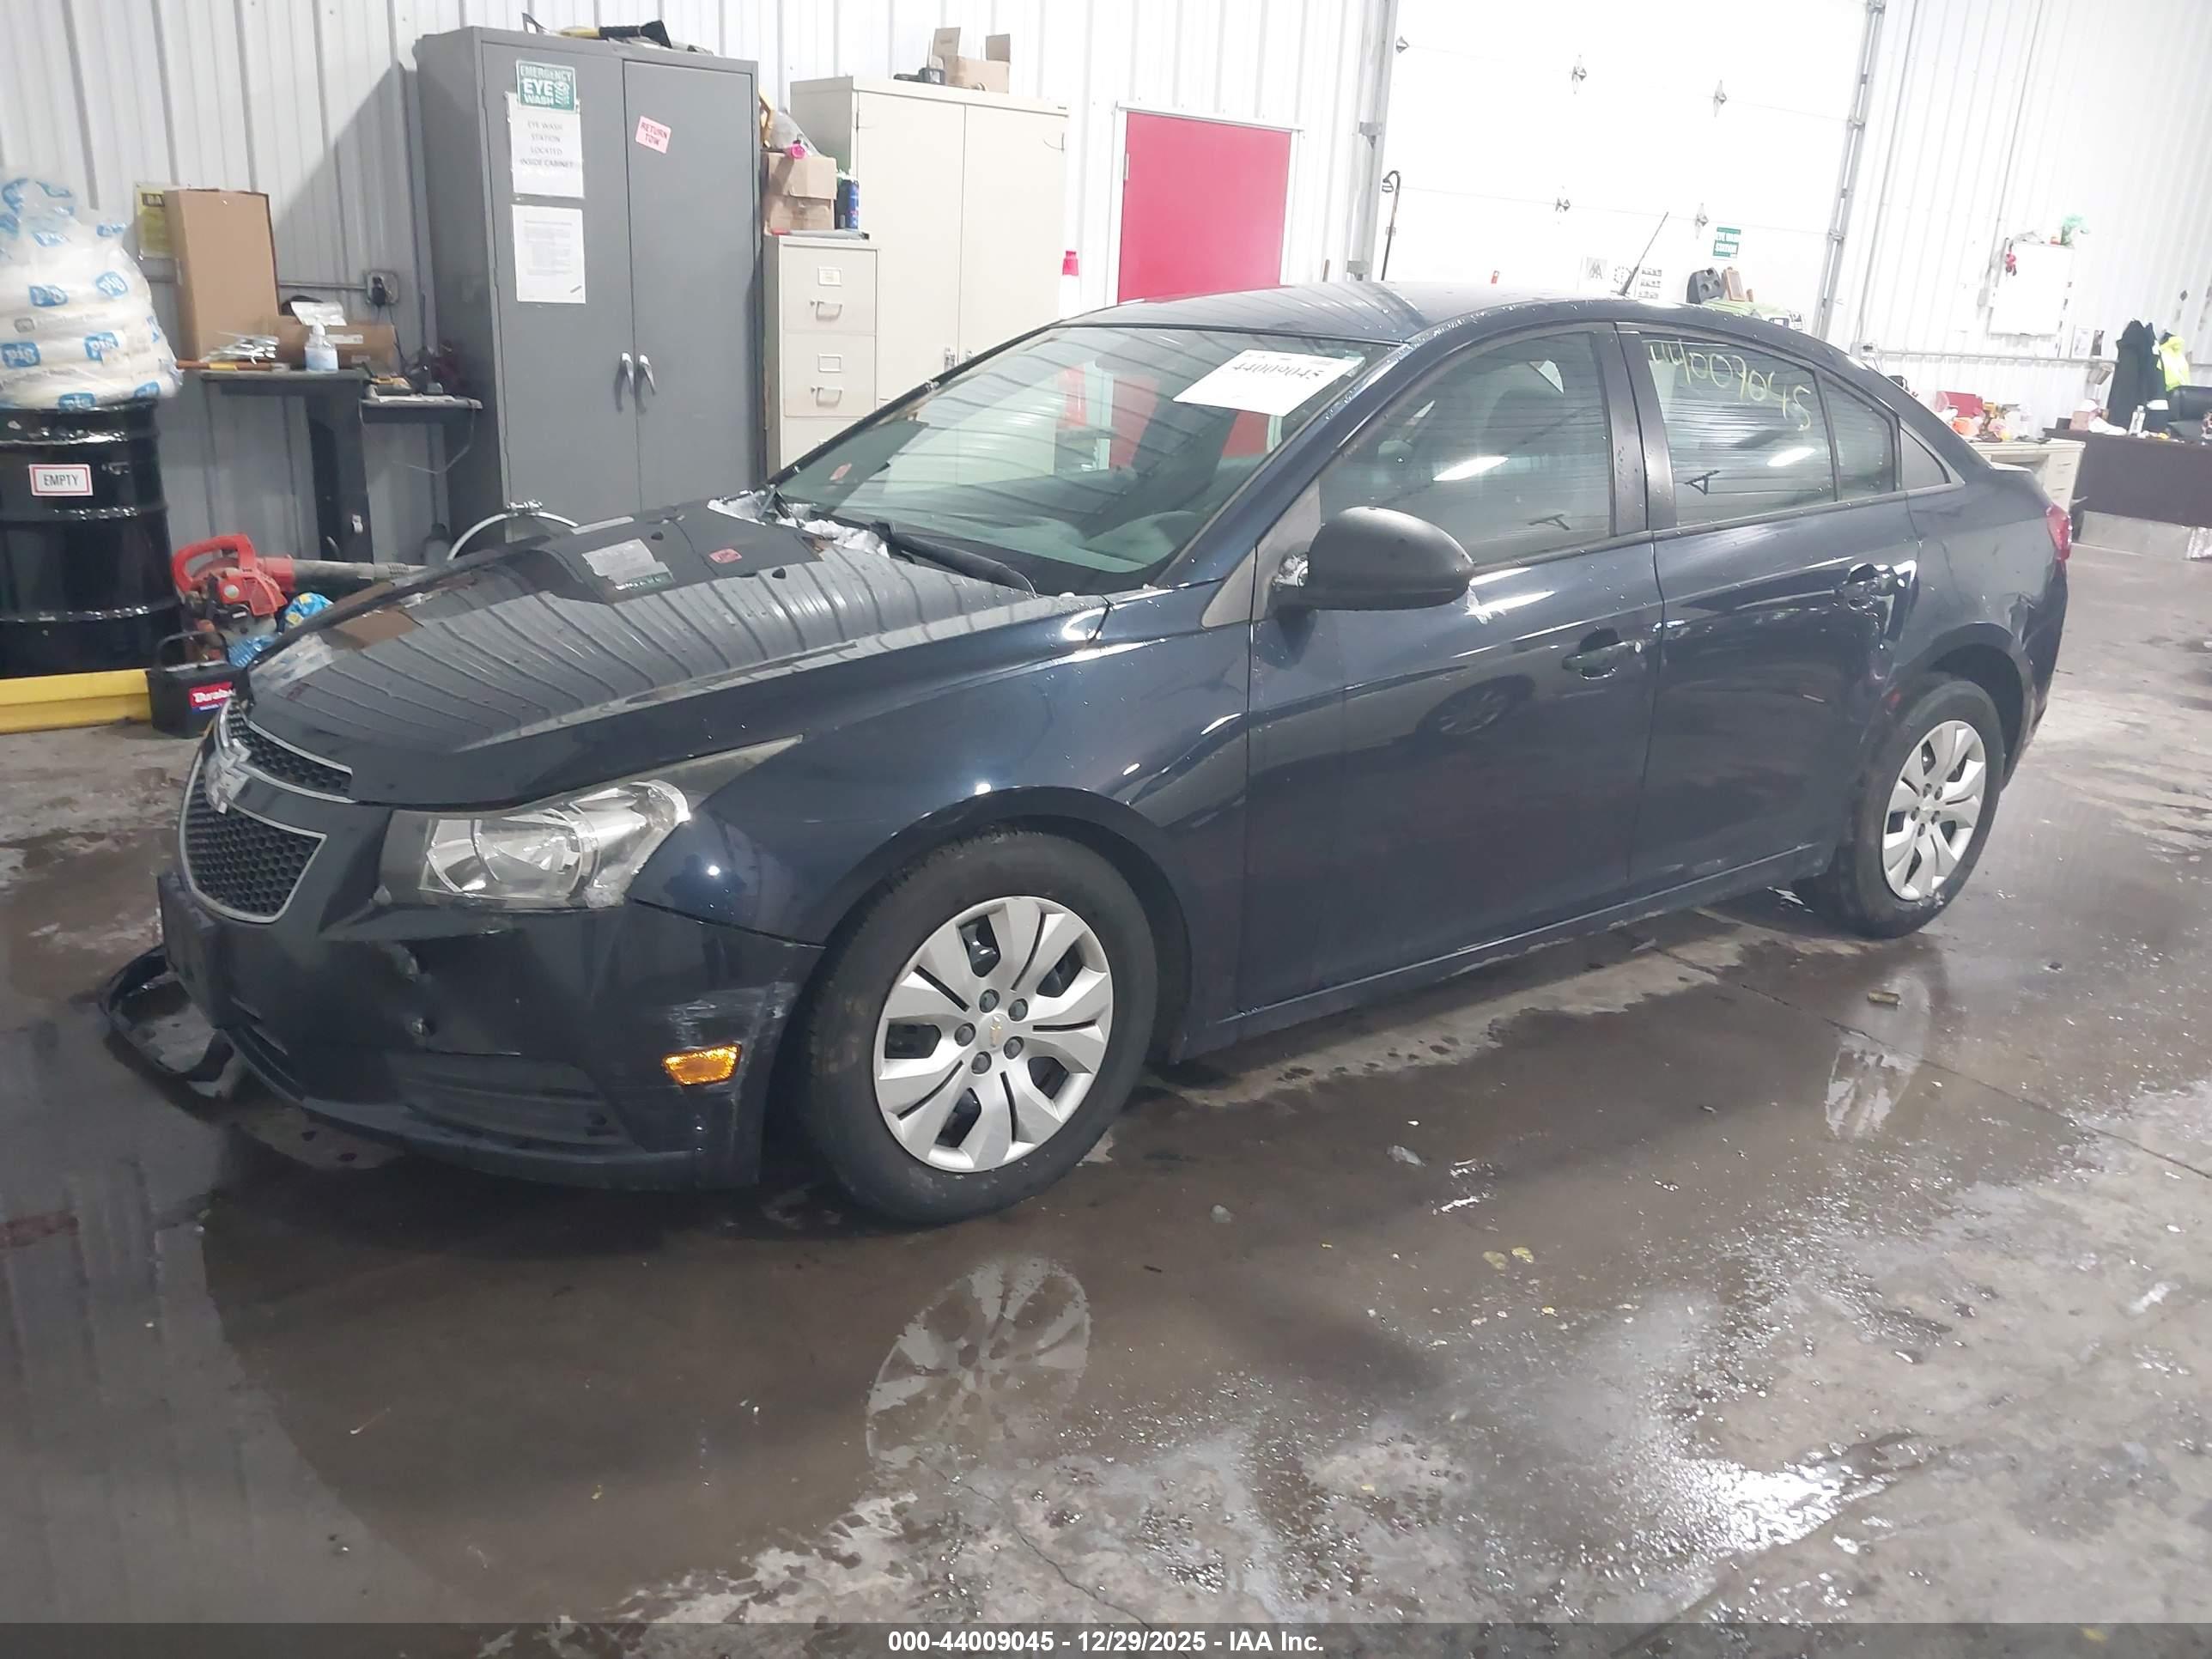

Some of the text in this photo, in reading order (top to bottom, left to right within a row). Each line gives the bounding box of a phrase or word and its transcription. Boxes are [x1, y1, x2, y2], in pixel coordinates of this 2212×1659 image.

[520, 65, 573, 82] EMERGENCY
[522, 78, 555, 97] EYE
[525, 94, 555, 106] WASH
[641, 122, 668, 140] RETURN
[645, 132, 660, 146] TOW
[4, 344, 37, 366] pig
[43, 474, 79, 487] EMPTY
